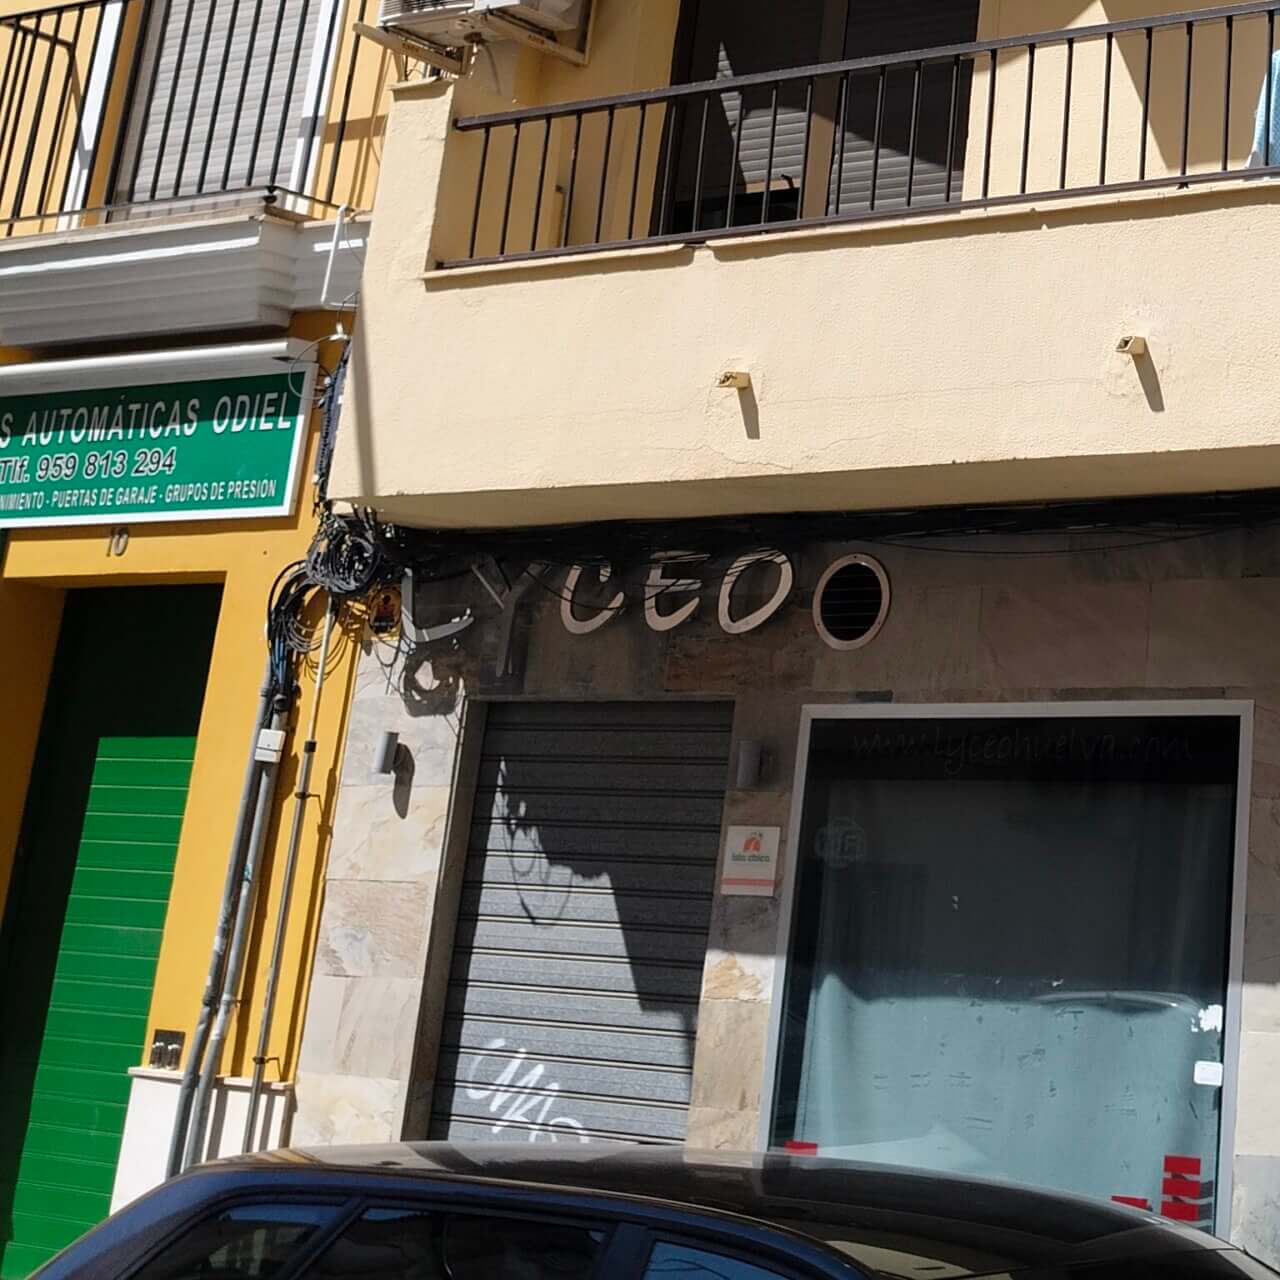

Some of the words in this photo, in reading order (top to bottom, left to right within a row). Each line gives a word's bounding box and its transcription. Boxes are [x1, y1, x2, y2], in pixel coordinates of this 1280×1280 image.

[22, 395, 200, 446] AUTOMÁTICAS
[213, 391, 292, 433] ODIEL
[36, 453, 79, 481] 959
[83, 450, 128, 479] 813
[131, 446, 177, 476] 294
[51, 488, 98, 508] PUERTAS
[99, 487, 114, 506] DE
[115, 485, 158, 505] GARAJE
[165, 482, 208, 502] GRUPOS
[210, 481, 226, 500] DE
[226, 473, 277, 499] PRESIÓN
[401, 547, 793, 677] LYCEO
